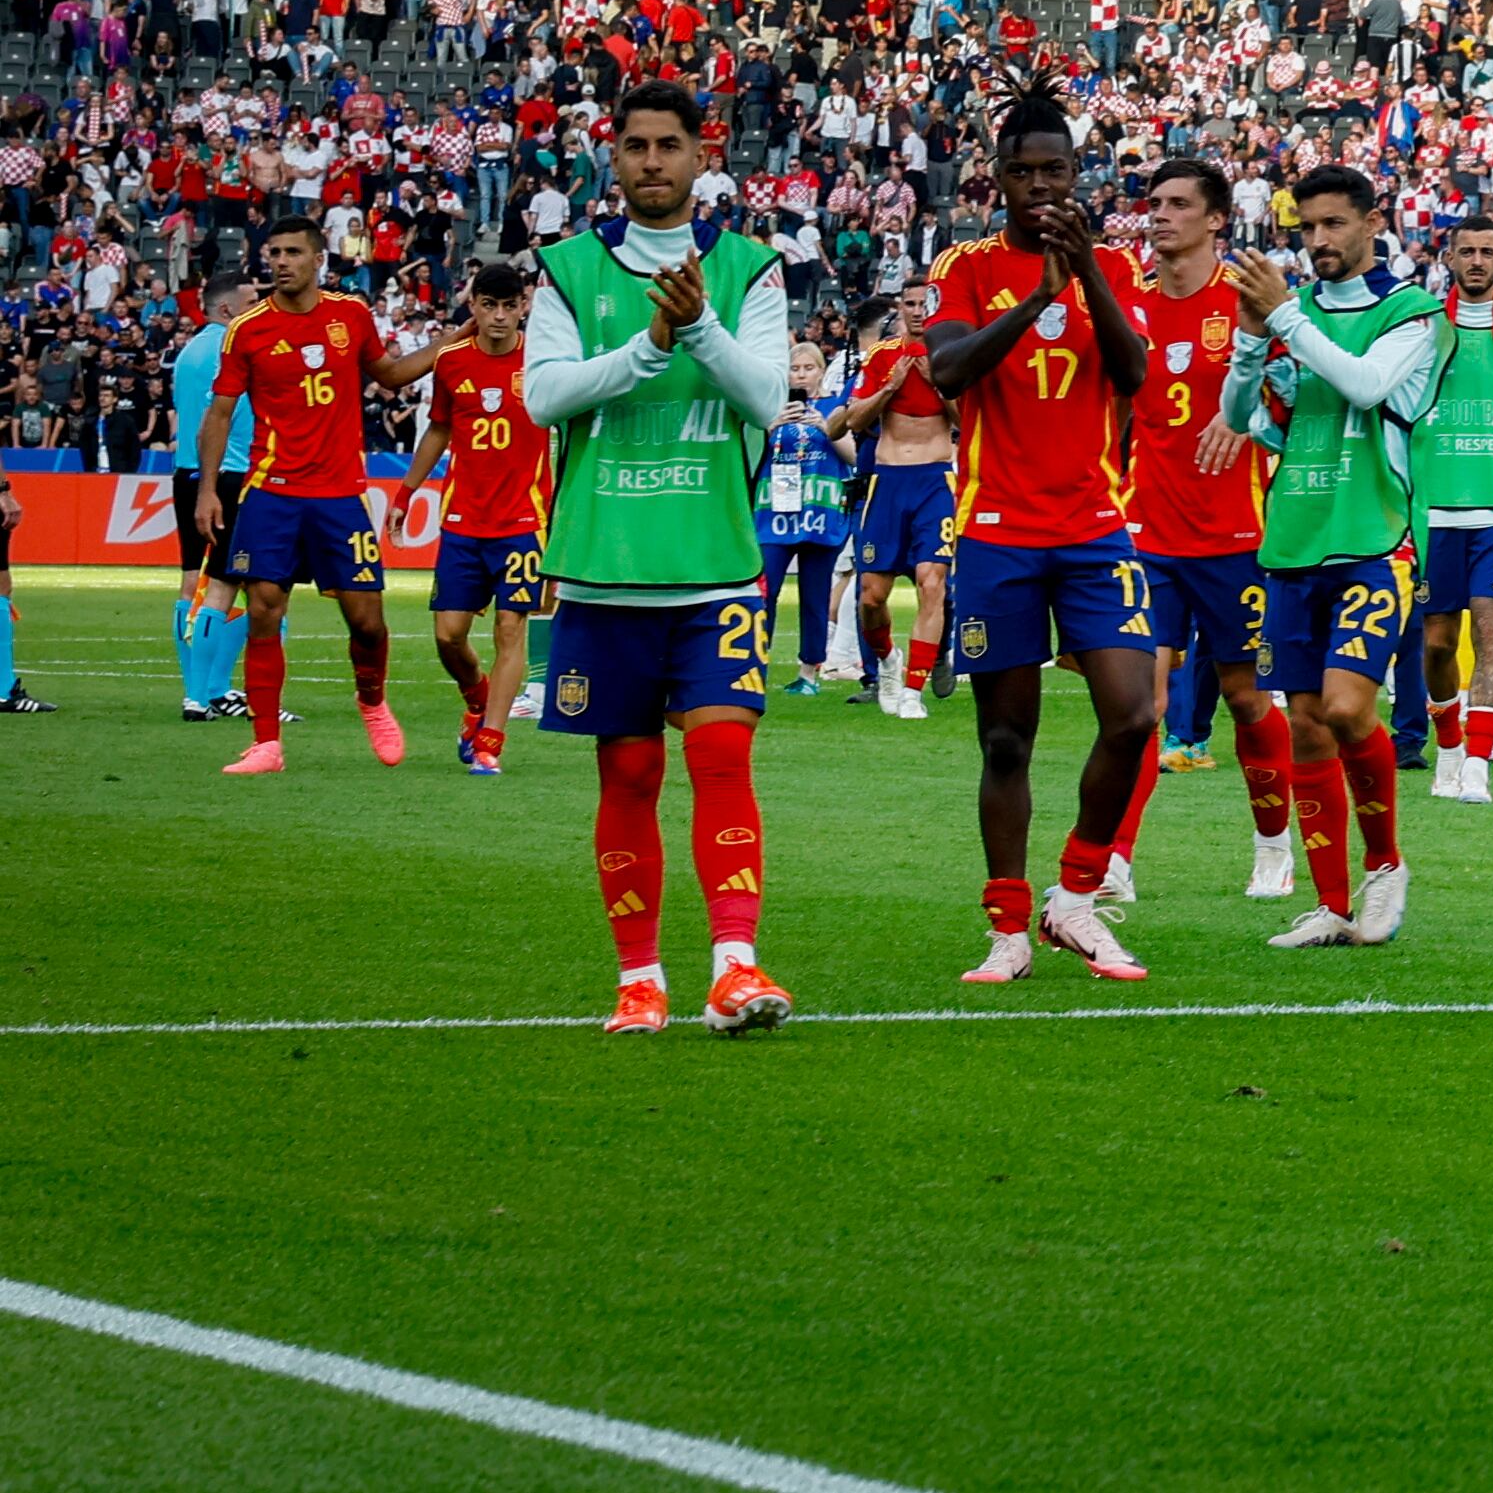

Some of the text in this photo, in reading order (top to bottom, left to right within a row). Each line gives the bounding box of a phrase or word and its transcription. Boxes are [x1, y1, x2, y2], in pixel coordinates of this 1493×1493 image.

[299, 371, 336, 407] 16
[1027, 348, 1079, 400] 17
[1167, 381, 1191, 426] 3
[471, 416, 511, 450] 20
[617, 466, 709, 488] RESPECT
[347, 531, 380, 564] 16
[940, 516, 955, 543] 8
[505, 550, 541, 584] 20
[1112, 560, 1151, 610] 17
[1240, 585, 1266, 630] 3
[1338, 585, 1396, 638] 22
